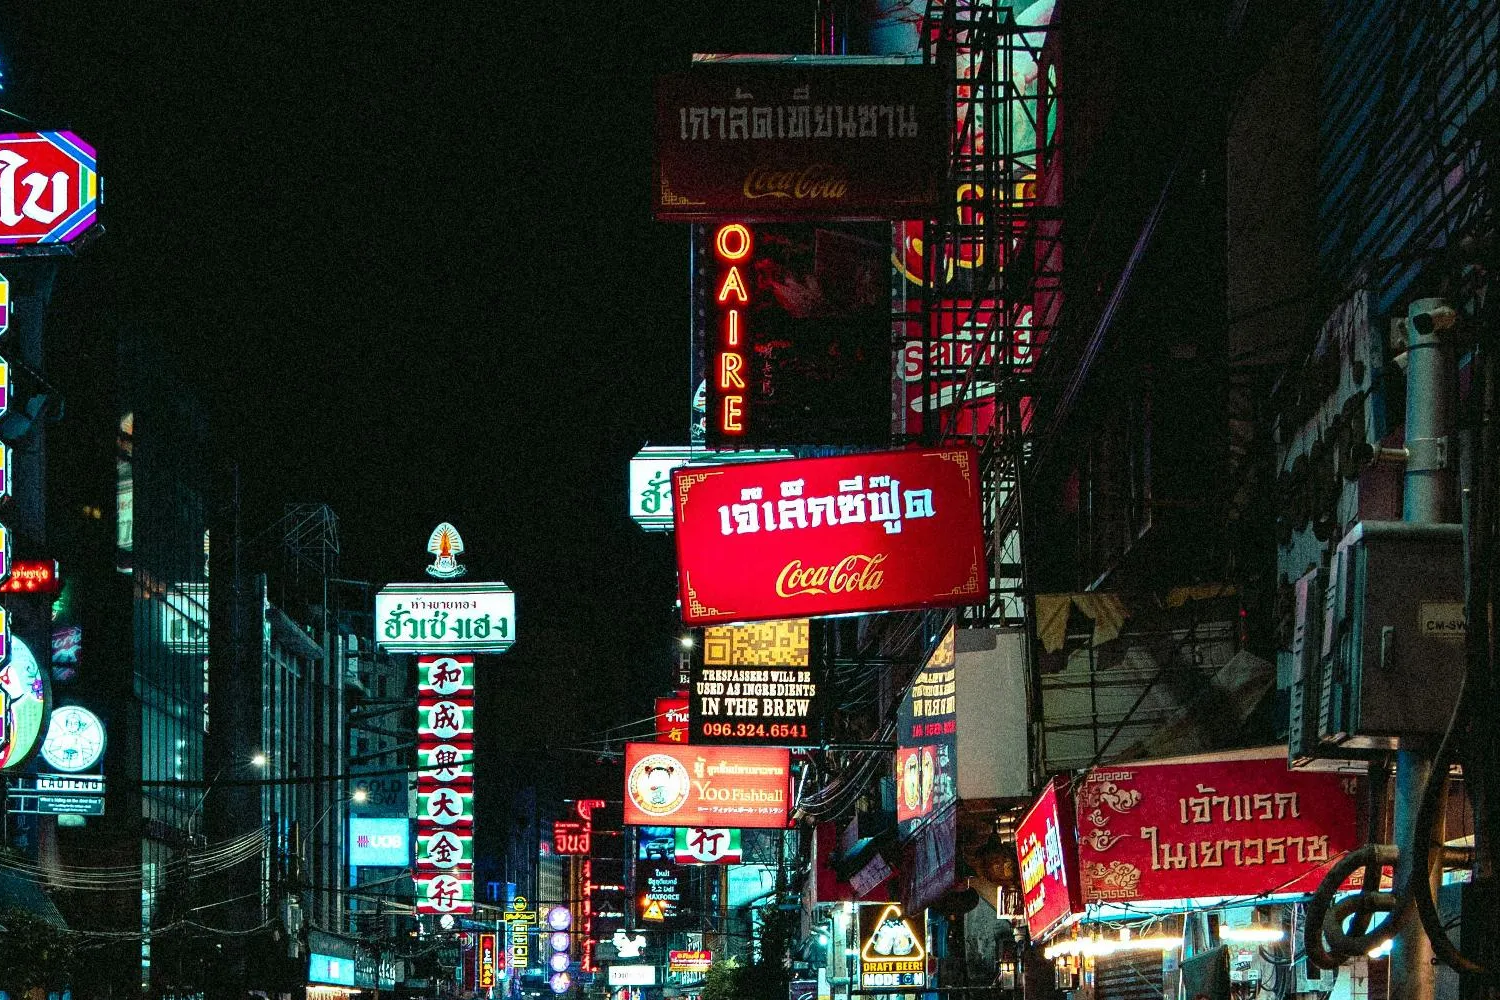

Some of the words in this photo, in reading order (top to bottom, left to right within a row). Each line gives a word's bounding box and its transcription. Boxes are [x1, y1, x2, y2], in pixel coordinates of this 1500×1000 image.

[743, 163, 848, 198] Coca-Cola
[776, 553, 888, 598] Coca-Cola
[702, 669, 768, 682] TRESPASSERS
[770, 670, 796, 682] WILL
[798, 671, 811, 683] BE
[697, 682, 724, 695] USED
[726, 683, 741, 696] AS
[743, 683, 816, 697] INGREDIENTS
[701, 697, 720, 716] IN
[725, 698, 758, 716] THE
[762, 699, 810, 716] BREW
[703, 722, 808, 738] 096.324.6541
[732, 789, 783, 802] Fishball
[1179, 784, 1300, 825] เจ้าแรก
[371, 834, 402, 848] UOB
[690, 828, 724, 855] 行
[1140, 826, 1330, 870] ในเยาวราช
[863, 961, 893, 972] DRAFT
[895, 961, 923, 972] BEER!
